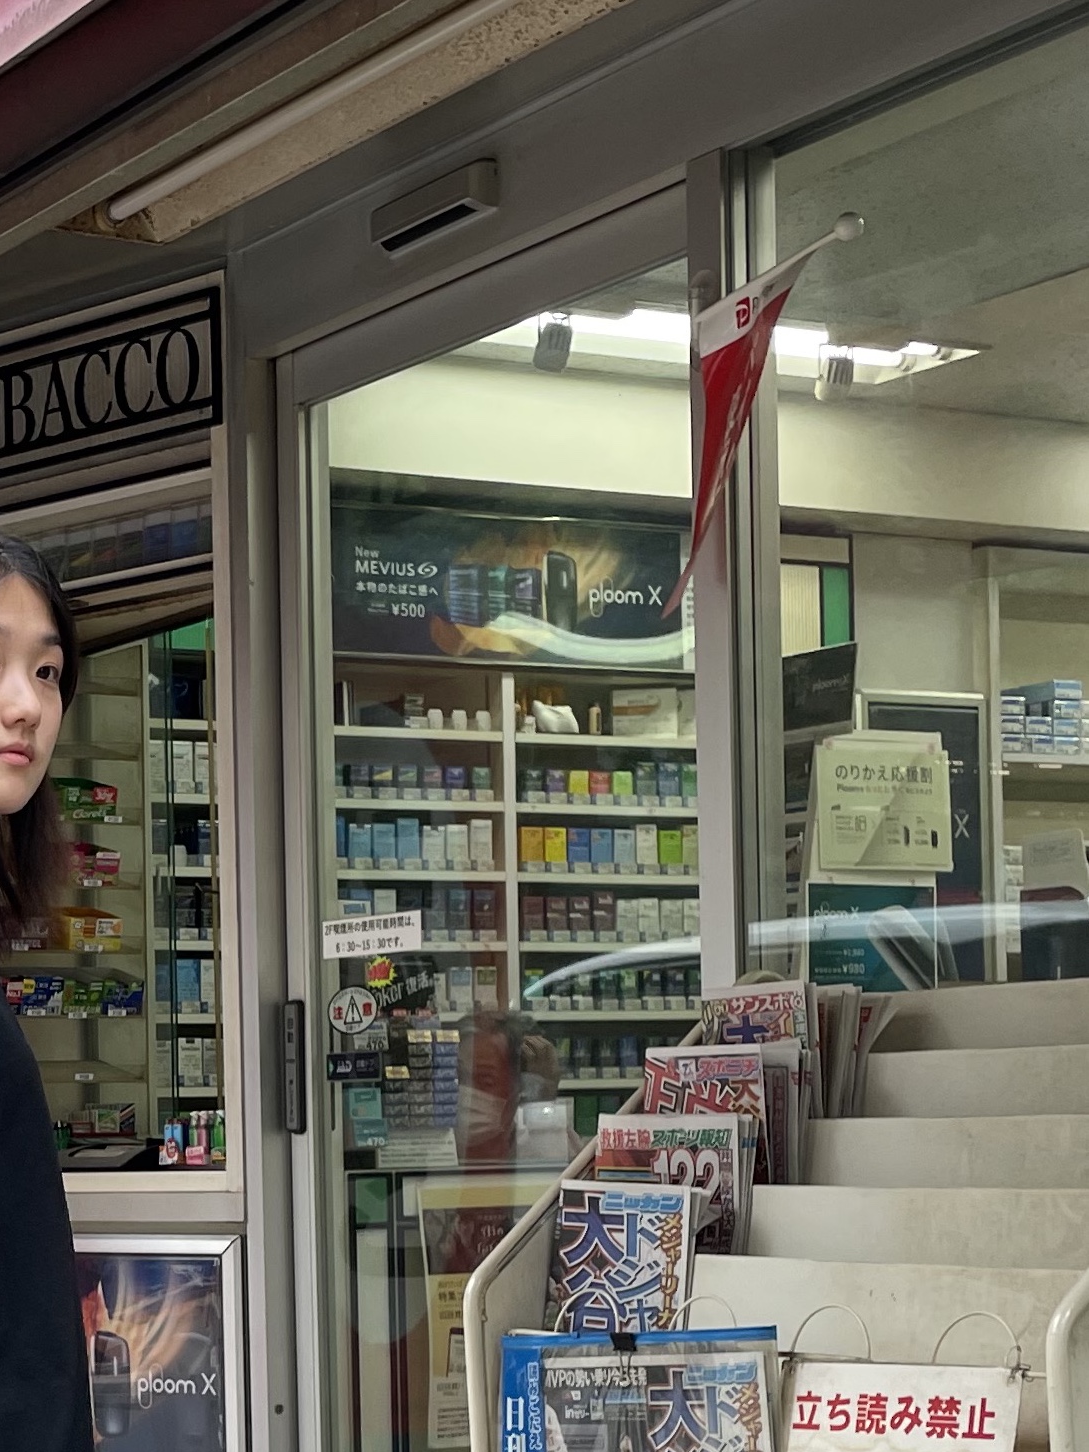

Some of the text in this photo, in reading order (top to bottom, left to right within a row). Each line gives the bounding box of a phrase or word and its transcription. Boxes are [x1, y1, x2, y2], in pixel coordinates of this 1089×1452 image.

[355, 546, 380, 559] New
[355, 560, 416, 577] MEVIUS
[648, 586, 663, 606] X
[391, 603, 426, 619] ¥500
[699, 1056, 759, 1080] スポニチ
[601, 1191, 685, 1214] ニッカン
[561, 1192, 627, 1332] 大谷
[201, 1373, 217, 1395] X
[793, 1390, 996, 1441] 立ち読み禁止
